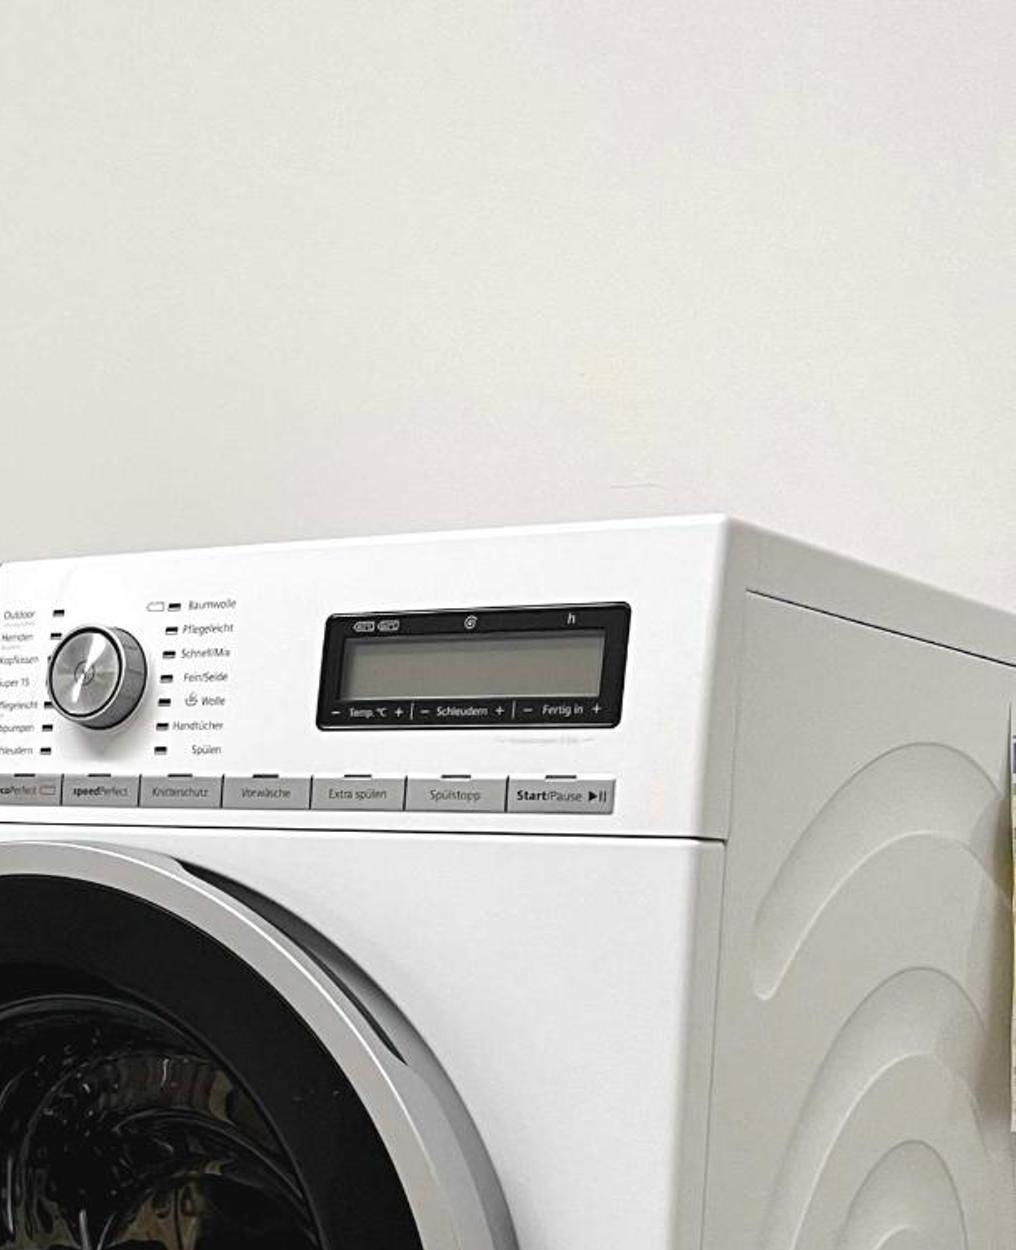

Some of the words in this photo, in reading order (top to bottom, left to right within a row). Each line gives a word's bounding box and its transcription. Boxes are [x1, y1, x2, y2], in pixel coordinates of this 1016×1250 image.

[188, 598, 237, 610] Baumwolle
[4, 610, 35, 620] Outdoor
[567, 612, 577, 625] h
[202, 696, 226, 706] Wolle
[348, 706, 375, 719] Temp.
[436, 705, 489, 717] Schleudern
[542, 703, 571, 716] Fertig
[573, 704, 584, 715] in
[191, 744, 222, 756] Spülen
[73, 786, 129, 798] speedPerfect
[328, 788, 354, 800] Extra
[516, 788, 584, 802] Start/Pause
